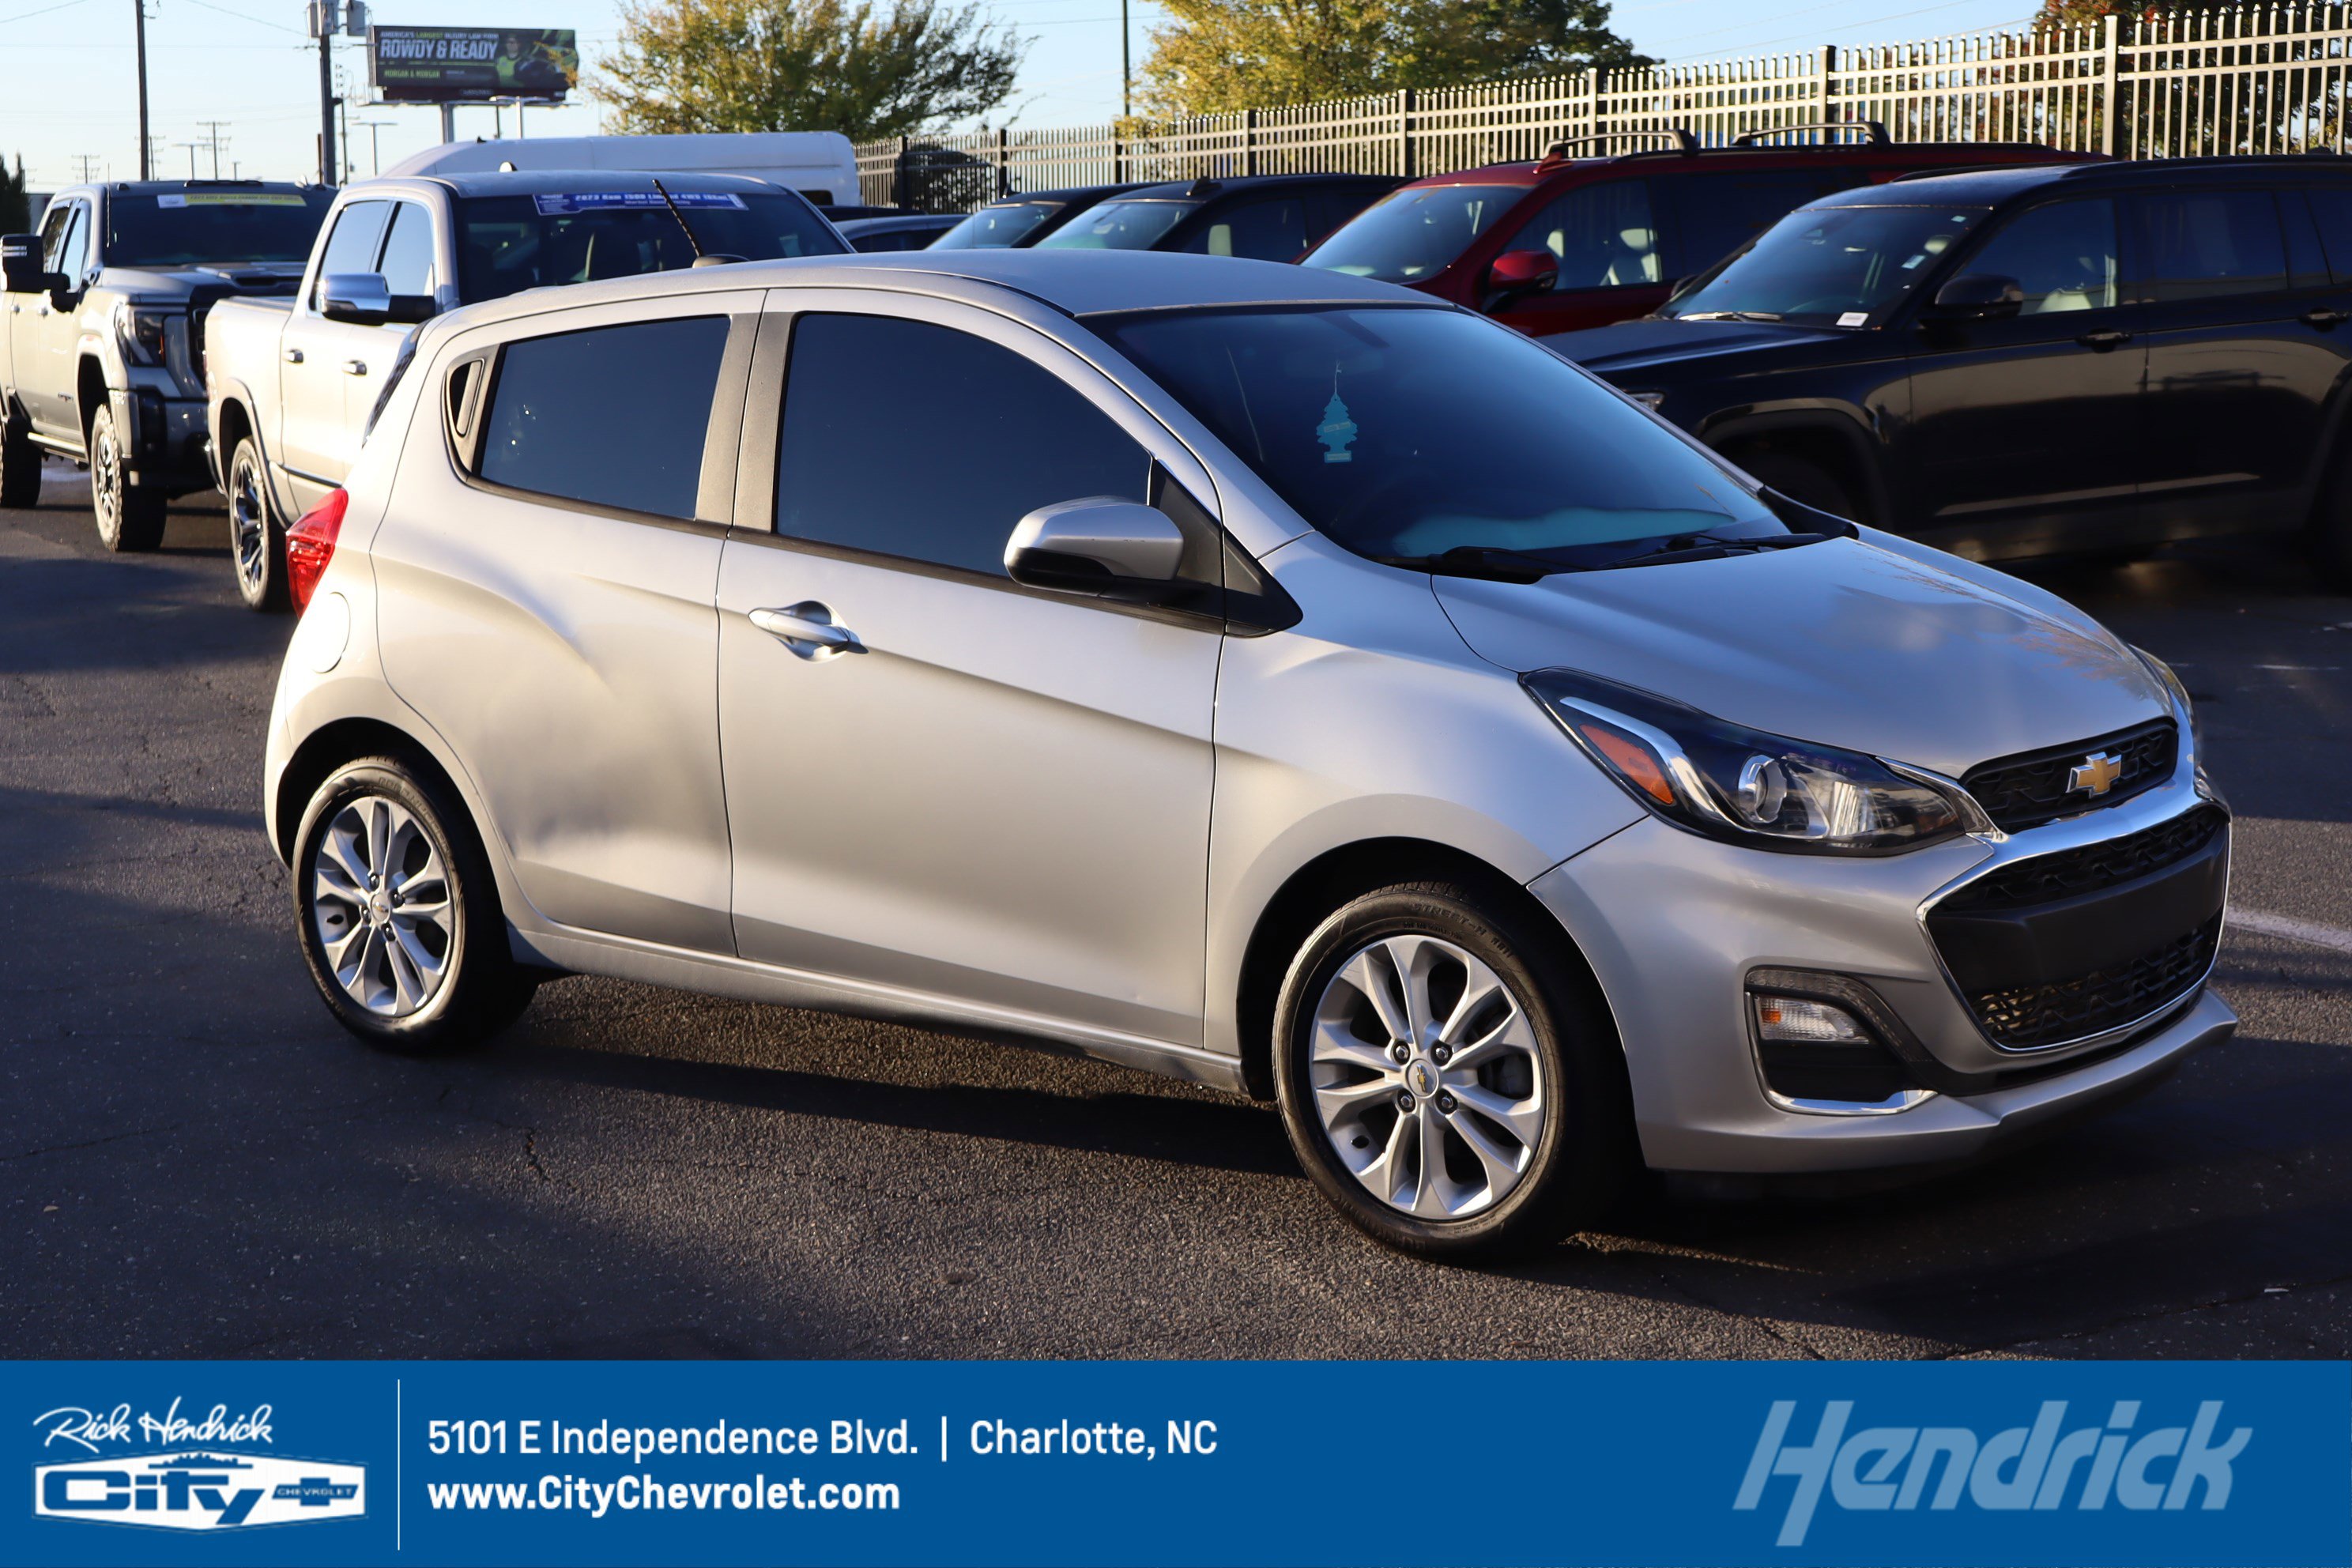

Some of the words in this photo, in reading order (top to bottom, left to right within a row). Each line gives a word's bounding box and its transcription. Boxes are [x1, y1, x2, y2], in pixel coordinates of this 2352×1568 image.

[380, 39, 435, 58] ROWDY
[436, 40, 447, 59] &
[449, 40, 499, 60] READY
